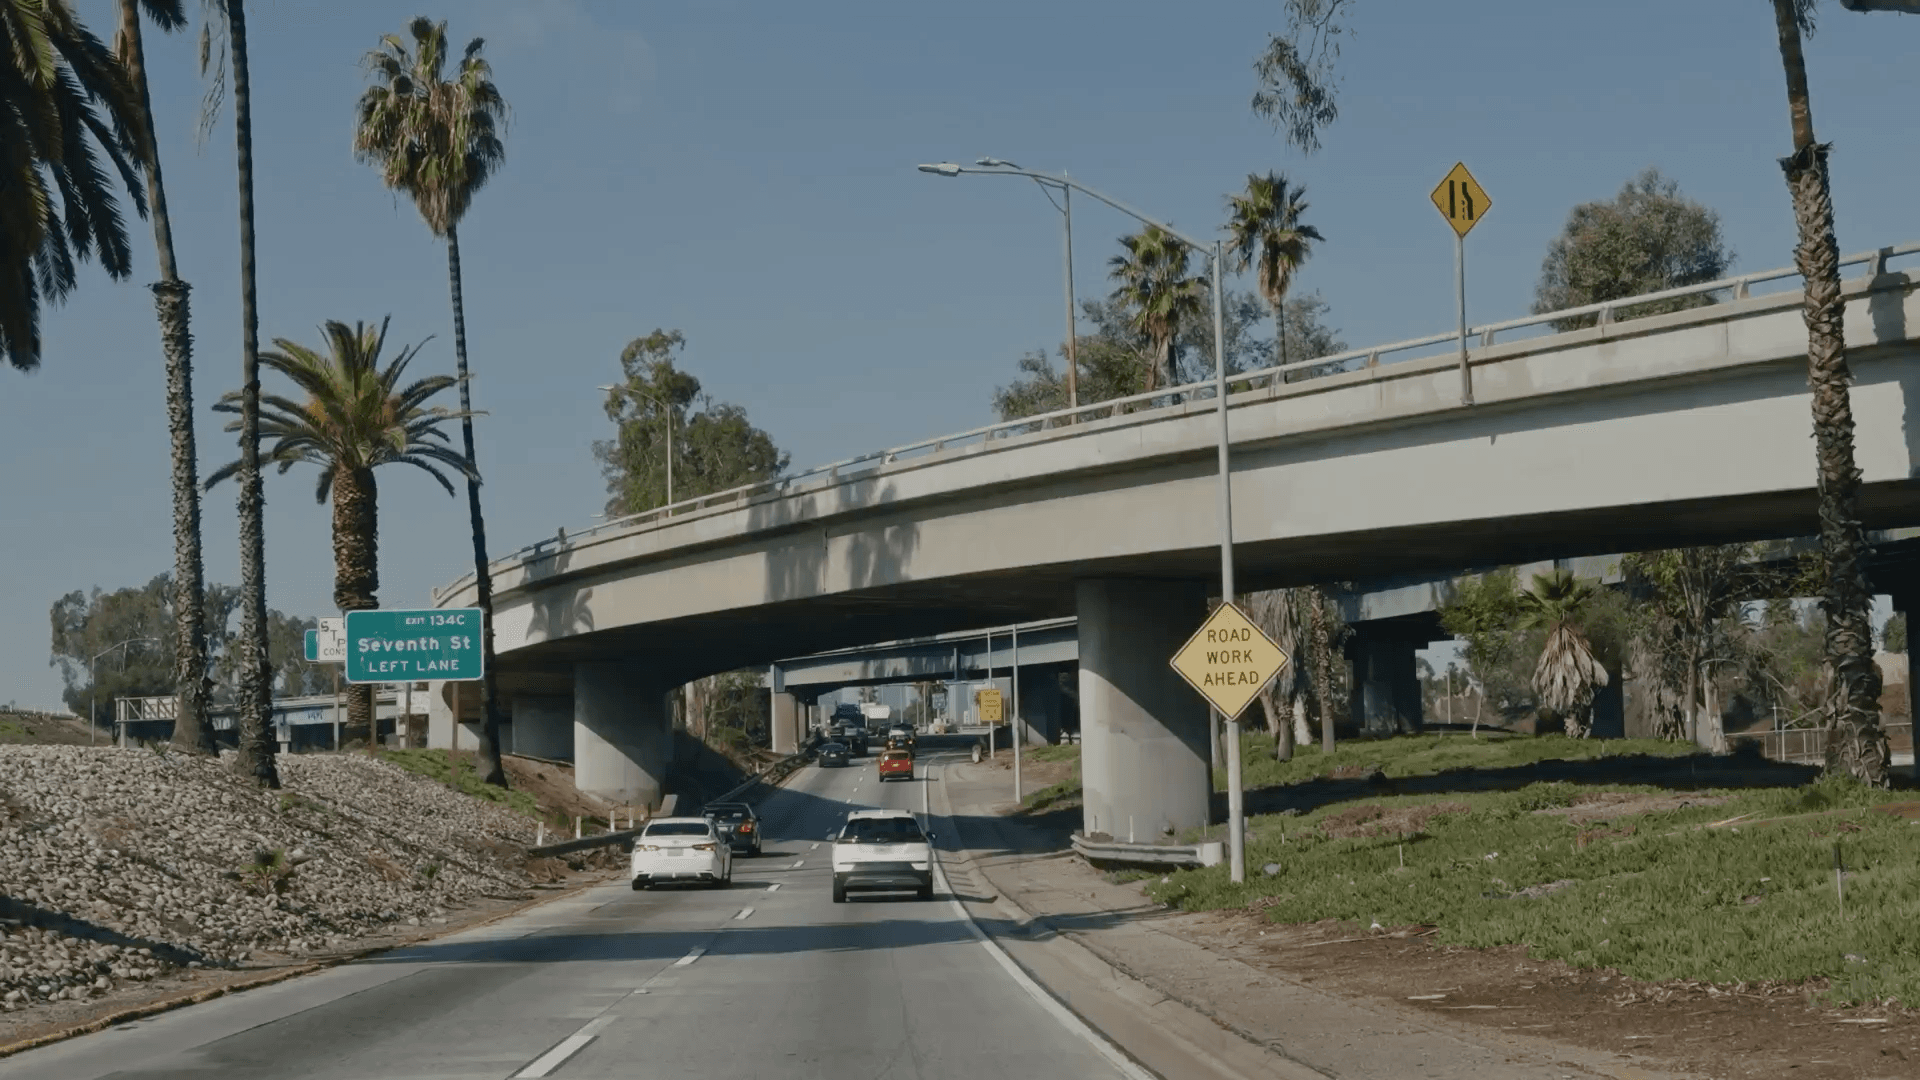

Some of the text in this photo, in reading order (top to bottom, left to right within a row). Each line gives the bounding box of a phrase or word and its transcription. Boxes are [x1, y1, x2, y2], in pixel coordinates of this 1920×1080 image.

[405, 614, 465, 626] EXIT 134C
[1207, 628, 1251, 643] ROAD
[358, 635, 471, 653] Seventh St
[1206, 649, 1254, 664] WORK
[368, 659, 460, 673] LEFT LANE
[1203, 671, 1259, 686] AHEAD
